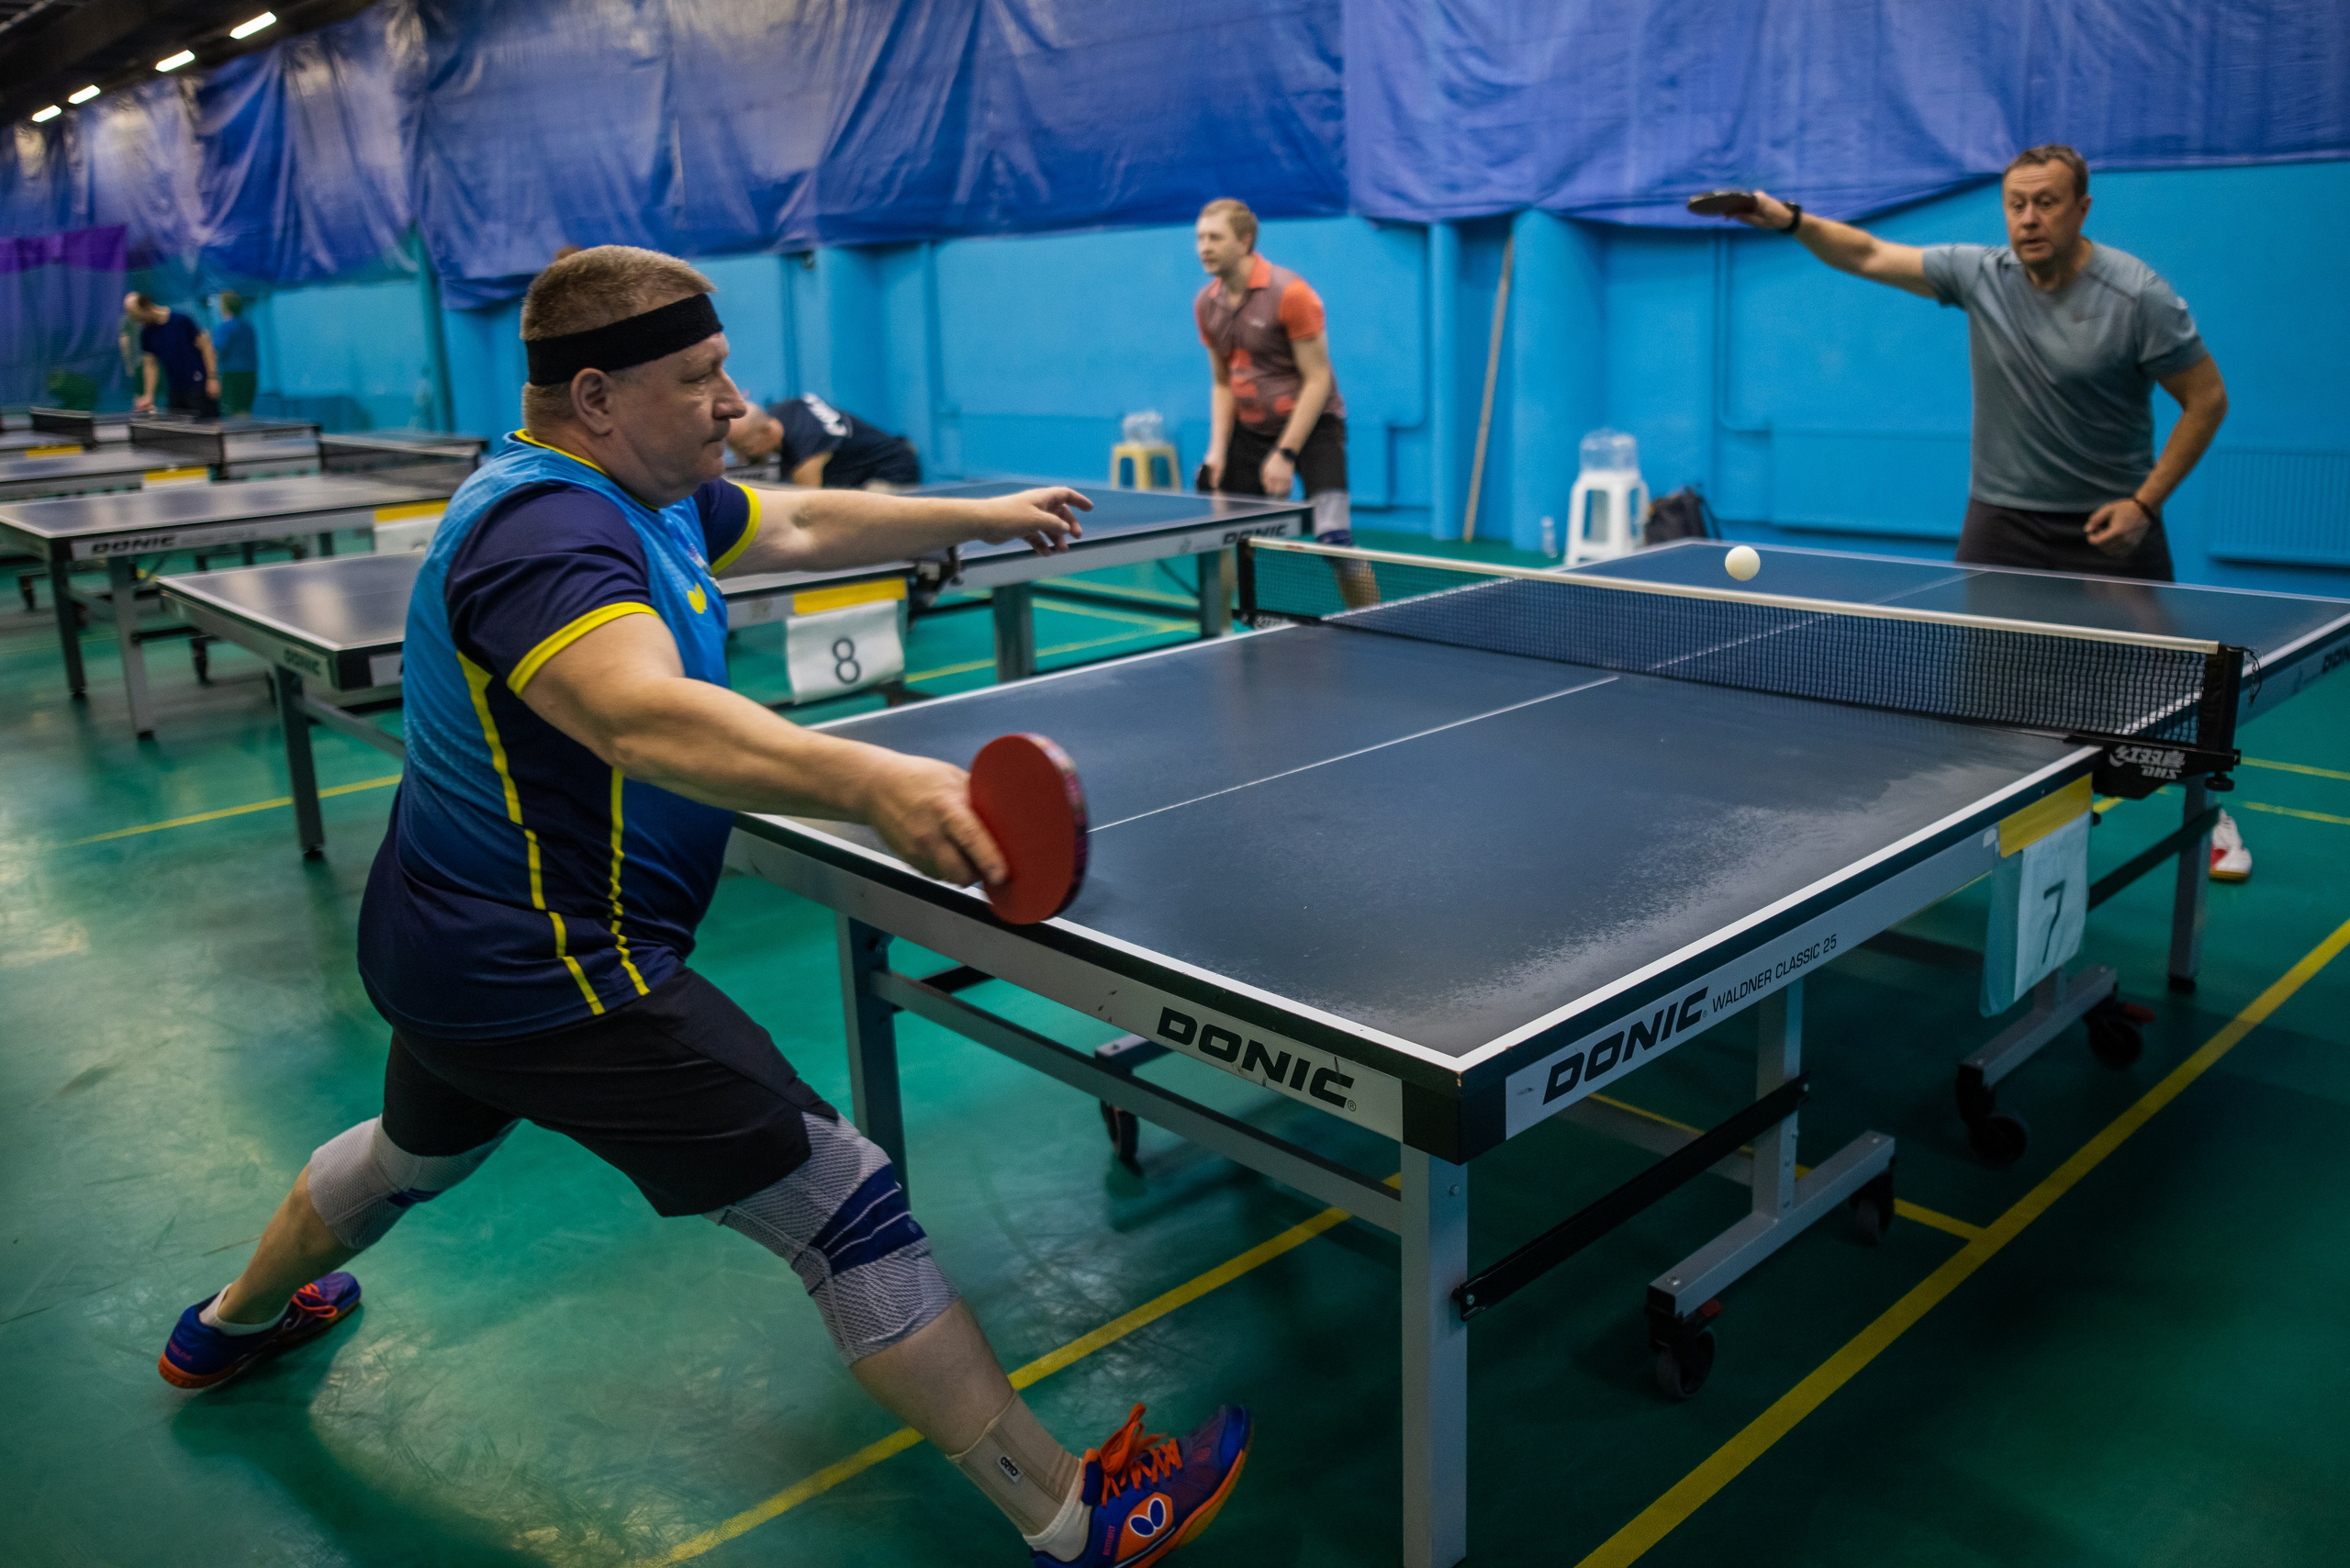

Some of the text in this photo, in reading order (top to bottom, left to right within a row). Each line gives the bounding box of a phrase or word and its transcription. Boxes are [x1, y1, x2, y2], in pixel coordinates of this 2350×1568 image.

[832, 637, 861, 686] 8
[2141, 766, 2182, 780] DHS
[2043, 879, 2065, 966] 7
[1542, 934, 1837, 1105] DONIC WALDNER CLASSIC 25
[1157, 1006, 1355, 1109] DONIC
[1001, 1456, 1019, 1476] ORTO
